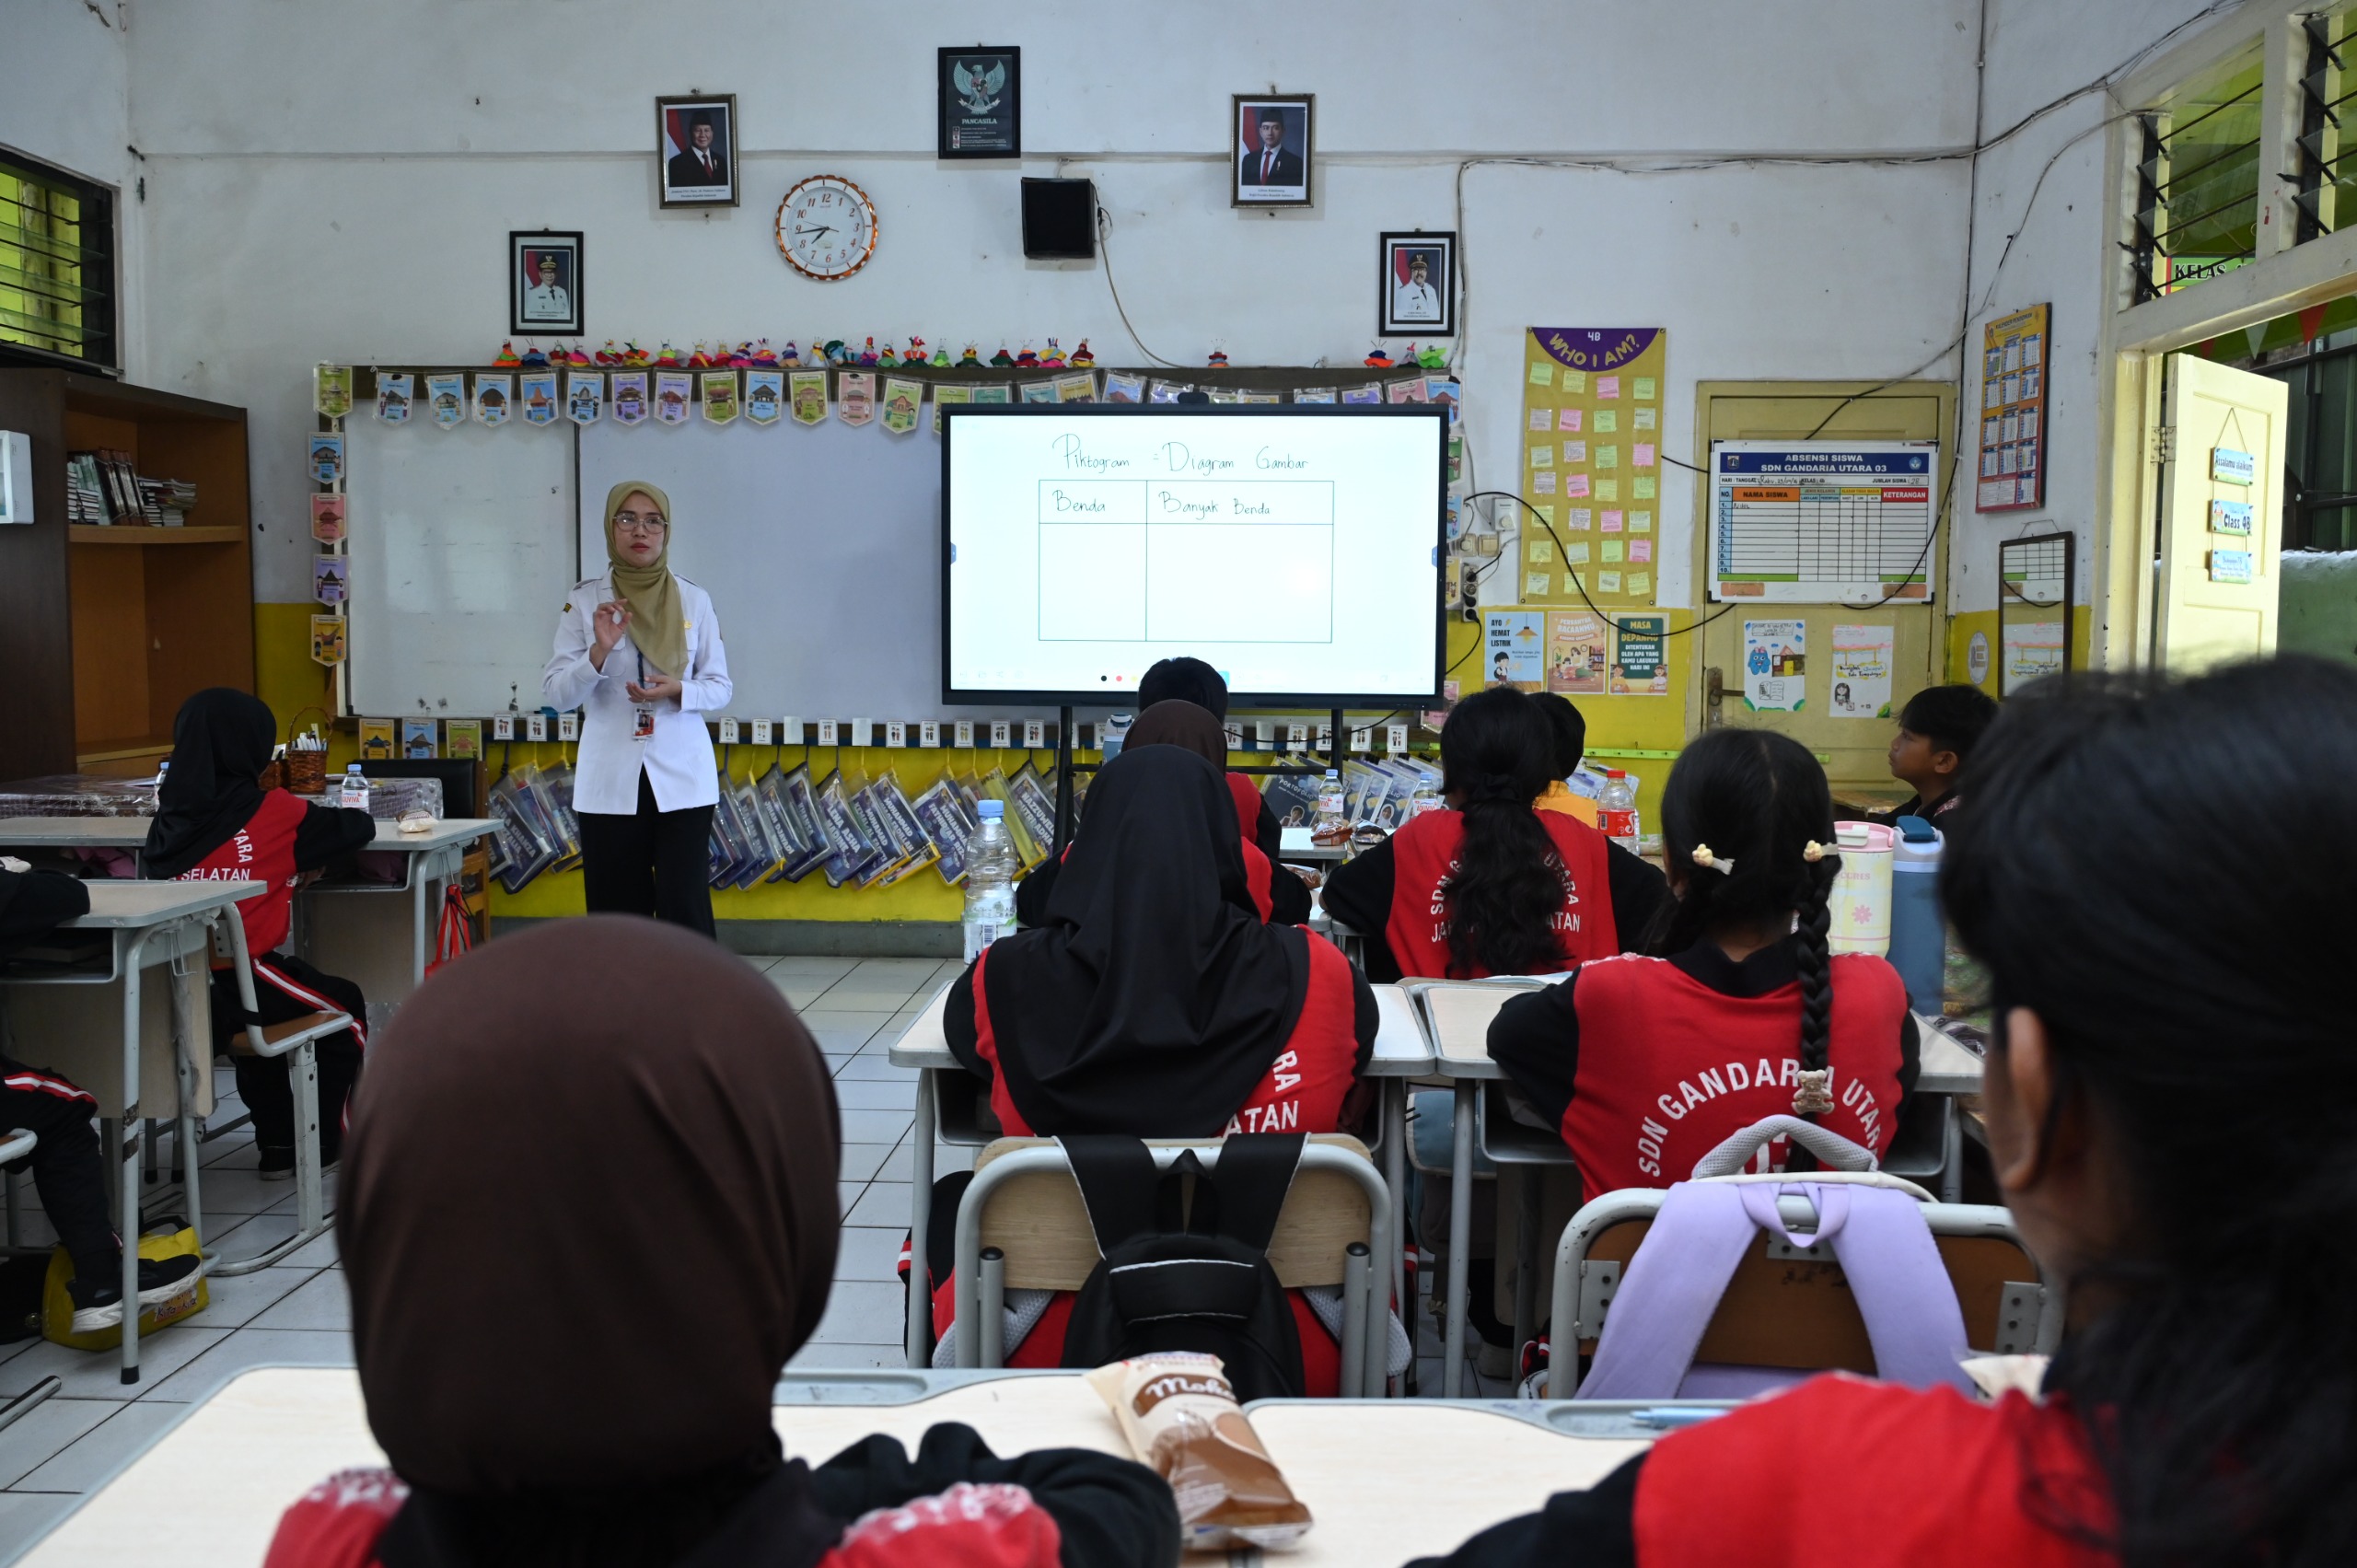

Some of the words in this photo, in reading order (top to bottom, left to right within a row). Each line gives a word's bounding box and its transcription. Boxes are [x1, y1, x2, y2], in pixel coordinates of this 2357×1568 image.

[807, 198, 816, 207] 11
[821, 193, 831, 203] 12
[839, 197, 843, 206] 1
[797, 209, 807, 218] 10
[849, 208, 855, 216] 2
[795, 225, 802, 234] 9
[853, 223, 860, 232] 3
[799, 239, 807, 249] 8
[851, 238, 857, 248] 4
[810, 250, 817, 259] 7
[825, 254, 832, 263] 6
[840, 250, 846, 259] 5
[2175, 263, 2226, 280] KELAS
[1587, 331, 1601, 342] 4B
[1549, 332, 1587, 366] WHO
[1593, 354, 1597, 367] I
[1605, 333, 1640, 366] AM?
[1052, 433, 1130, 473] Piktogram
[1162, 441, 1235, 476] Diagram
[1256, 447, 1309, 470] Gambar
[1785, 454, 1829, 462] ABSENSI
[1831, 454, 1864, 462] SISWA
[1761, 464, 1782, 472] SDN
[1784, 464, 1836, 472] GANDARIA
[1839, 464, 1874, 472] UTARA
[1875, 464, 1887, 472] 03
[1052, 489, 1106, 513] Benda
[1158, 491, 1218, 520] Banyak
[1234, 497, 1271, 516] Benda
[2223, 513, 2240, 529] Class
[1492, 619, 1502, 627] AYO
[1630, 621, 1652, 630] MASA
[1278, 778, 1314, 800] PORTOFOLIO
[884, 797, 913, 837] MUHAMMAD
[764, 801, 779, 826] JIHAN
[774, 822, 795, 854] DJAYADI
[865, 808, 888, 846] MUHAMAD
[939, 805, 968, 849] MUHAMMA
[1034, 822, 1053, 847] ADHA
[842, 827, 861, 854] ASHA
[891, 820, 913, 852] FADILLAH
[233, 829, 253, 864] TARA
[177, 867, 250, 881] SELATAN
[1431, 874, 1453, 915] SDN
[1545, 912, 1580, 933] ATAN
[1222, 1100, 1299, 1139] ATAN
[1638, 1116, 1668, 1178] SDN
[1657, 1058, 1835, 1120] GANDARA
[1842, 1077, 1882, 1156] UTAR
